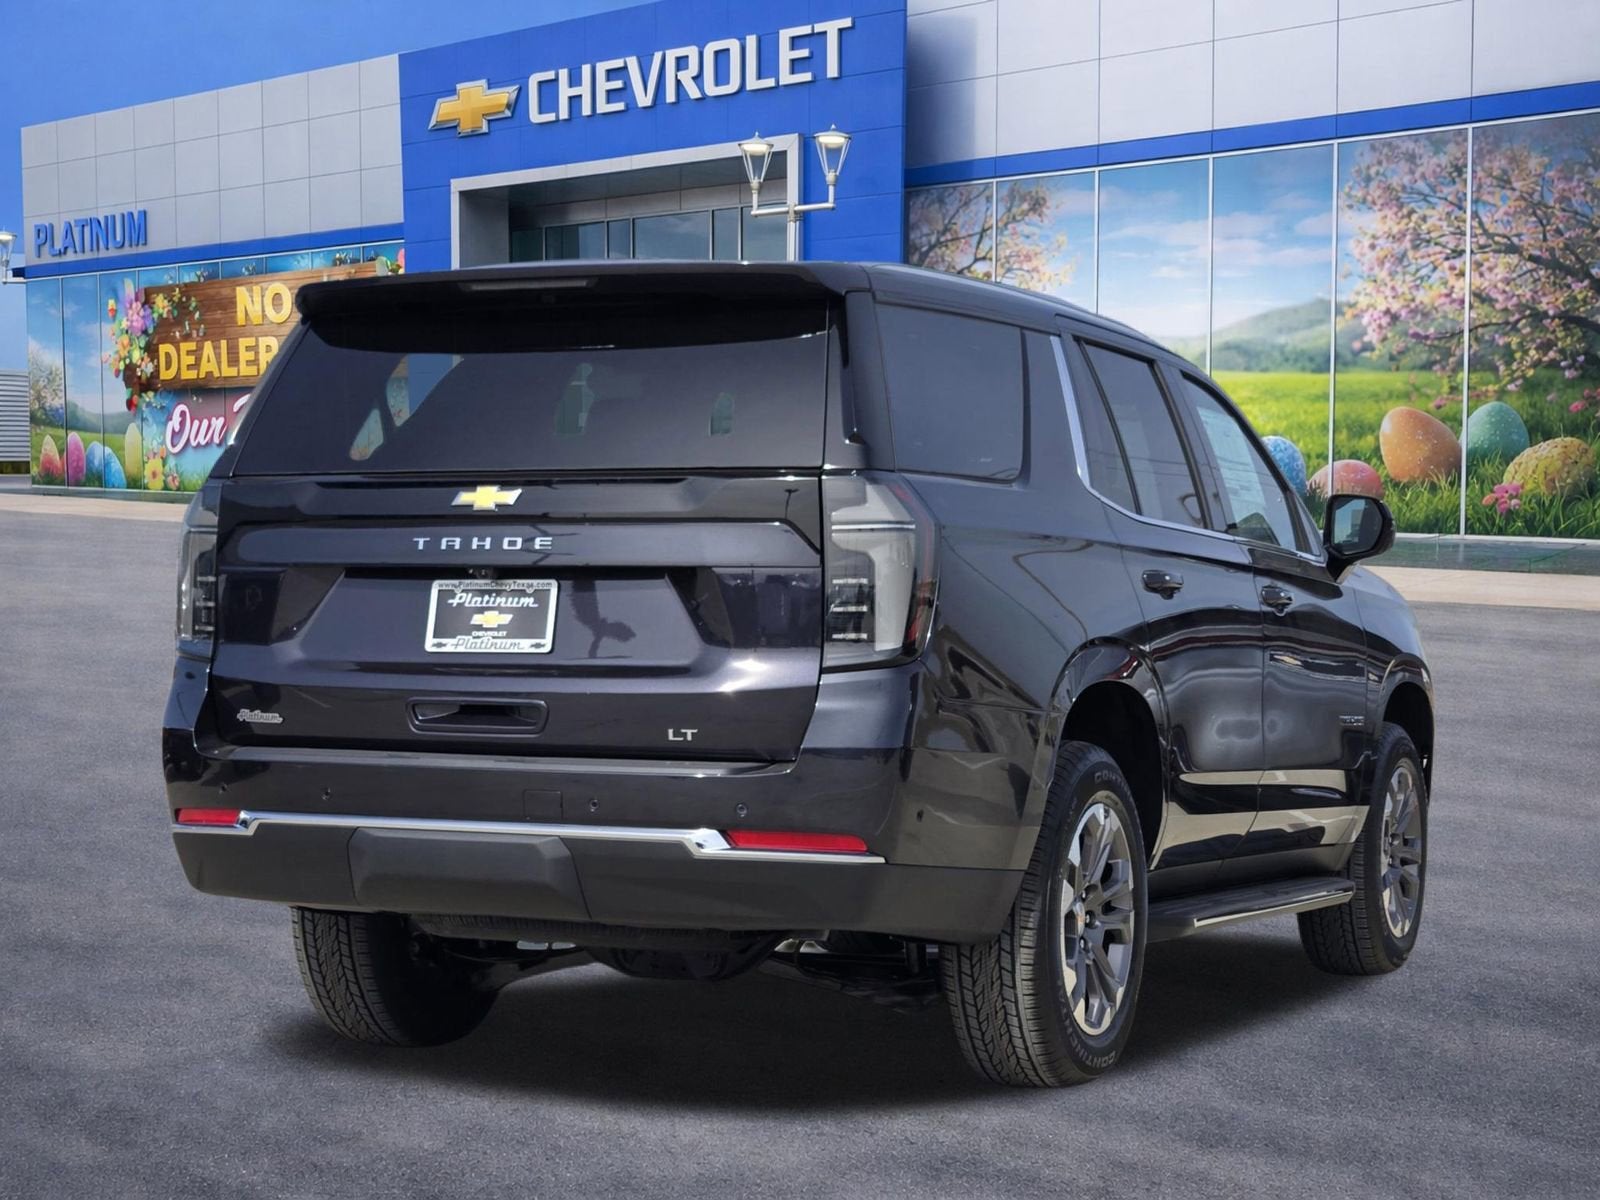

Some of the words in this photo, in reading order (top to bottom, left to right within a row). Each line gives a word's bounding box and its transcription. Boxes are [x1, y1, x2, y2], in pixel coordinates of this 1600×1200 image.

[528, 17, 854, 125] CHEVROLET
[34, 209, 147, 258] PLATINUM
[235, 282, 293, 326] NO
[158, 335, 280, 381] DEALER
[165, 404, 228, 454] Our
[412, 536, 553, 550] TAHOE
[447, 592, 539, 607] Platinum
[450, 637, 526, 651] Platinum
[667, 728, 699, 741] LT
